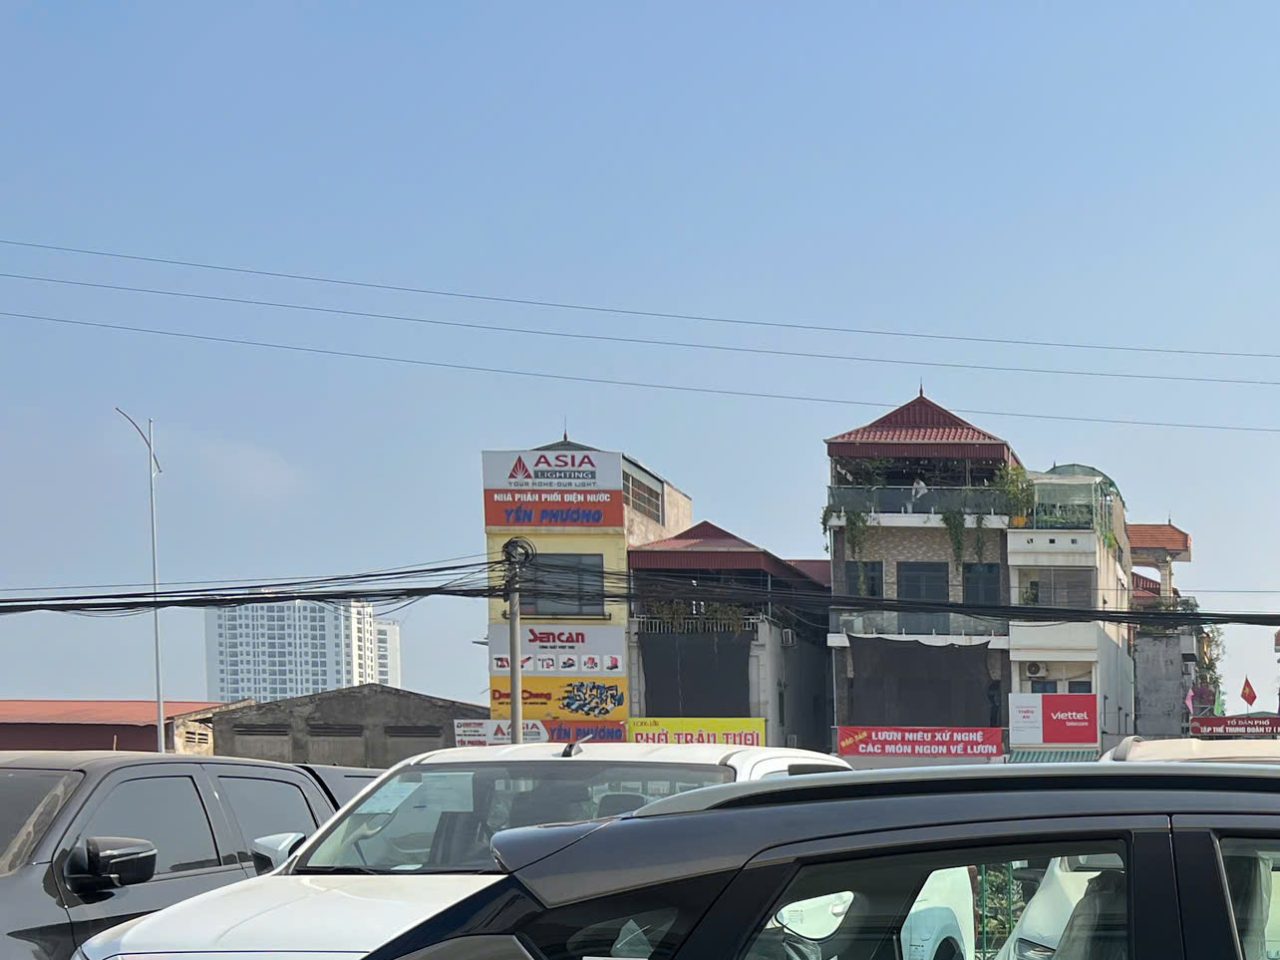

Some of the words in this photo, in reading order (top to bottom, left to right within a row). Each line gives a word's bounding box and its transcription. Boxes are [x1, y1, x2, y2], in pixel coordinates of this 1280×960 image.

[534, 454, 596, 468] ASIA
[537, 470, 592, 479] LIGHTING
[1051, 711, 1089, 720] viettel
[1225, 726, 1246, 734] TRUNG
[953, 731, 984, 743] NGHỆ
[858, 743, 882, 753] CÁC
[885, 743, 912, 753] MÓN
[914, 745, 948, 754] NGON
